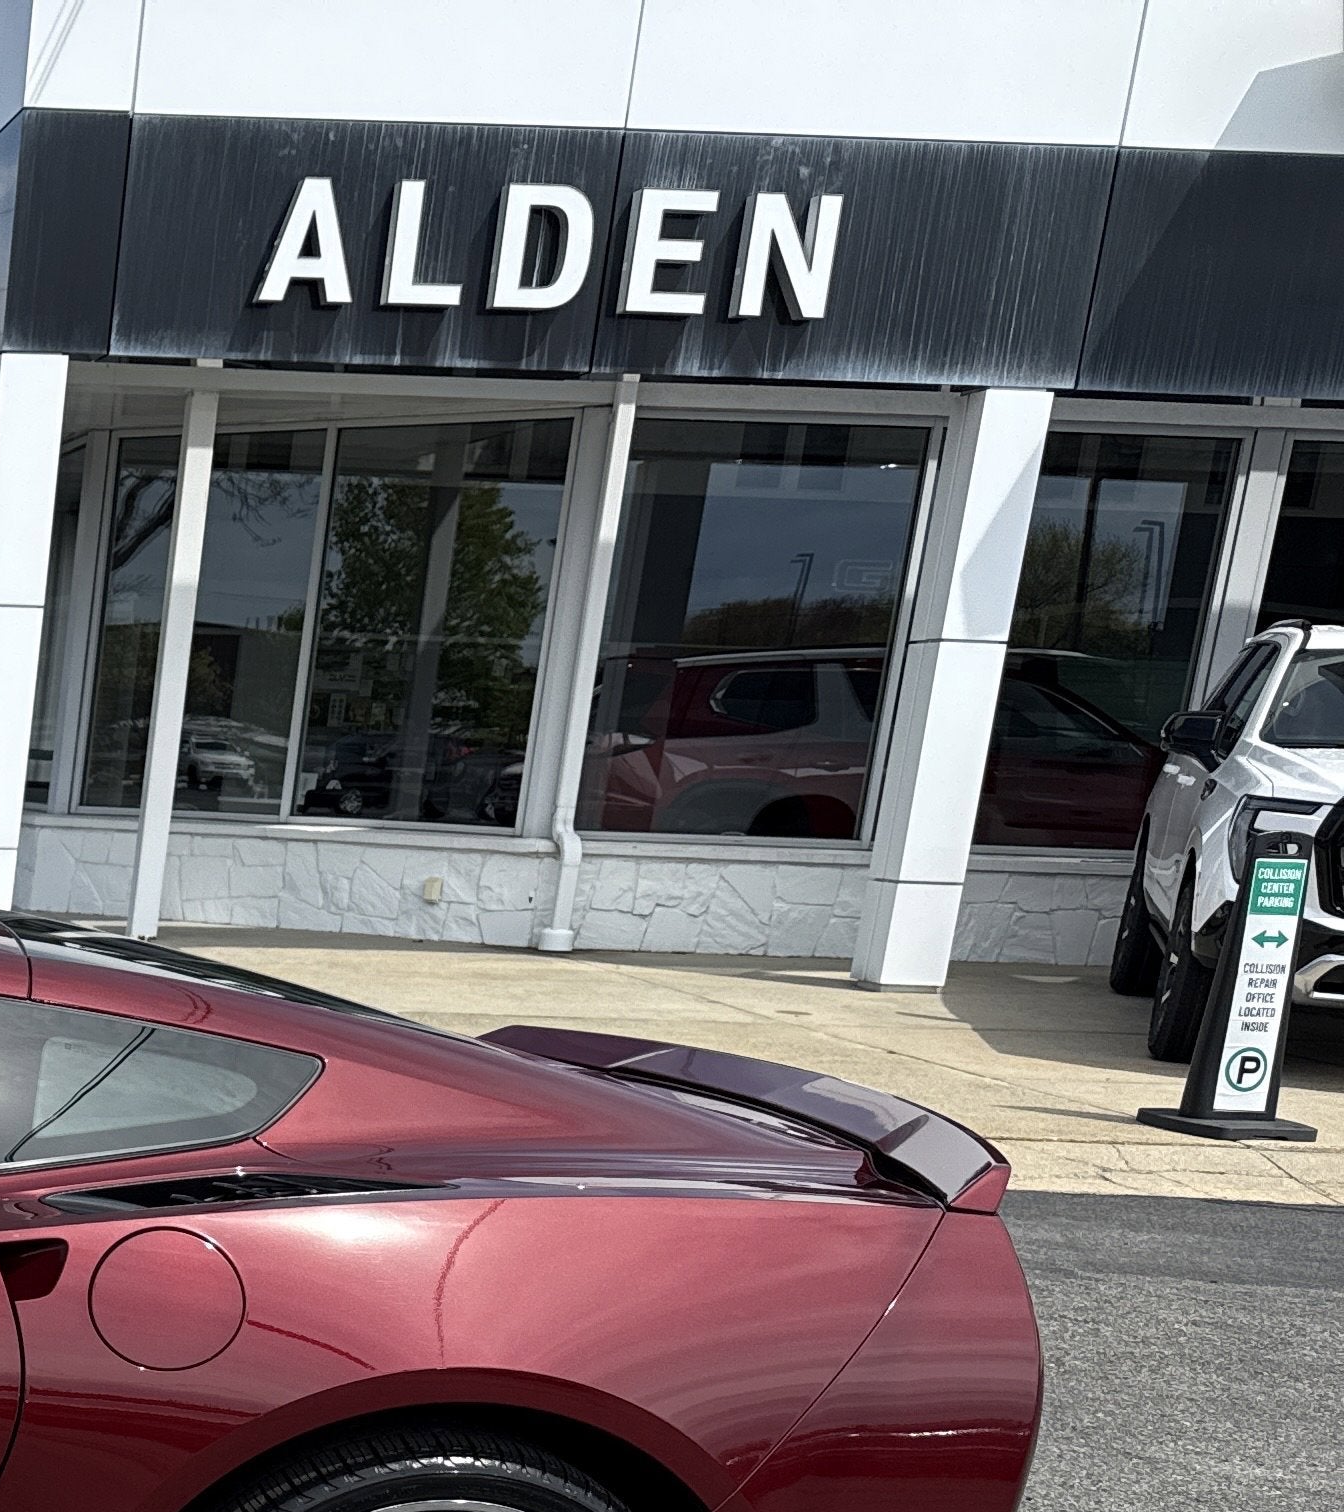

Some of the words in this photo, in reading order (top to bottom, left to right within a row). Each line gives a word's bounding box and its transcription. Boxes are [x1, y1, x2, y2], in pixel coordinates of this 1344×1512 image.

[253, 175, 844, 321] ALDEN
[1258, 867, 1303, 881] COLLISION
[1260, 882, 1295, 895] CENTER
[1257, 896, 1295, 908] PARKING
[1243, 962, 1286, 975] COLLISION
[1247, 977, 1278, 989] REPAIR
[1245, 992, 1276, 1004] OFFICE
[1238, 1005, 1276, 1018] LOCATED
[1240, 1020, 1269, 1033] INSIDE
[1236, 1055, 1261, 1085] P
